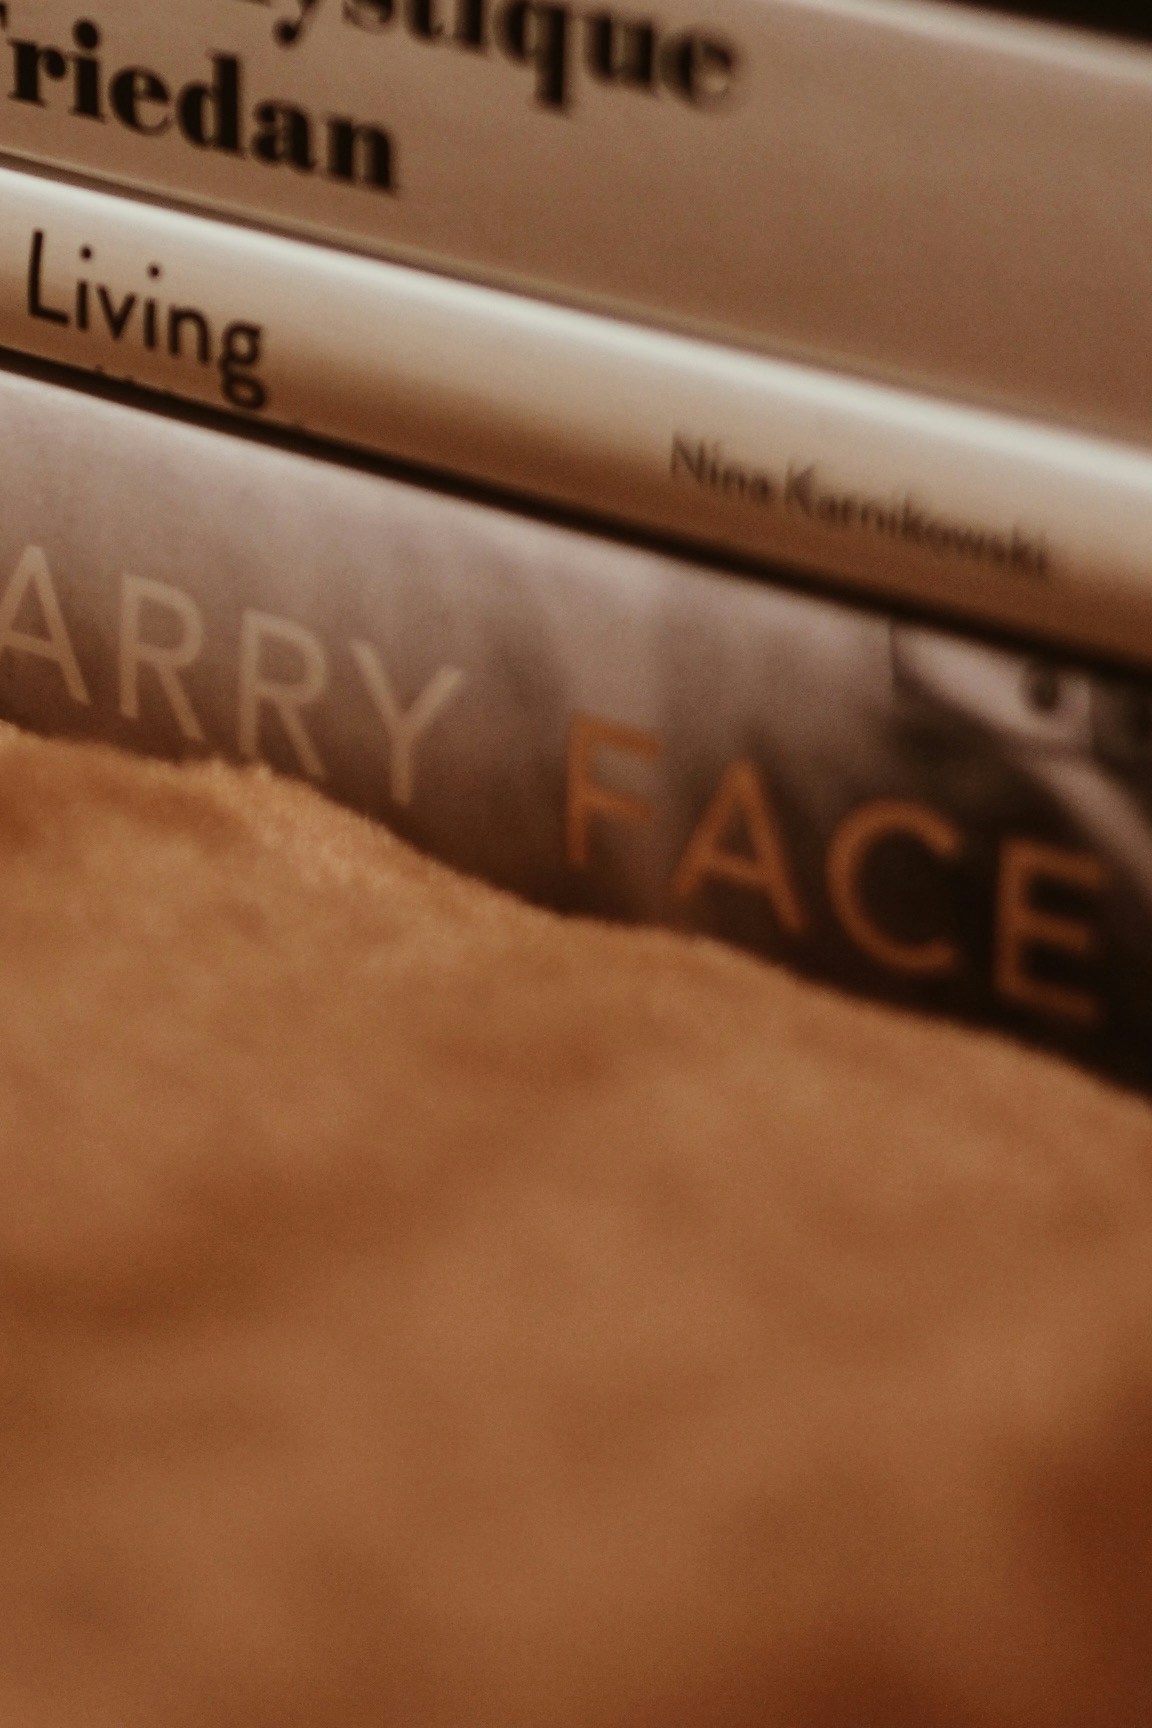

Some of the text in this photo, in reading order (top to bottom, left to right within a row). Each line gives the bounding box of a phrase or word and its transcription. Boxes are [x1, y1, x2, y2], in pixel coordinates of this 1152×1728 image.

[27, 230, 266, 410] Living
[670, 431, 771, 505] Nina
[564, 709, 1103, 1023] FACE
